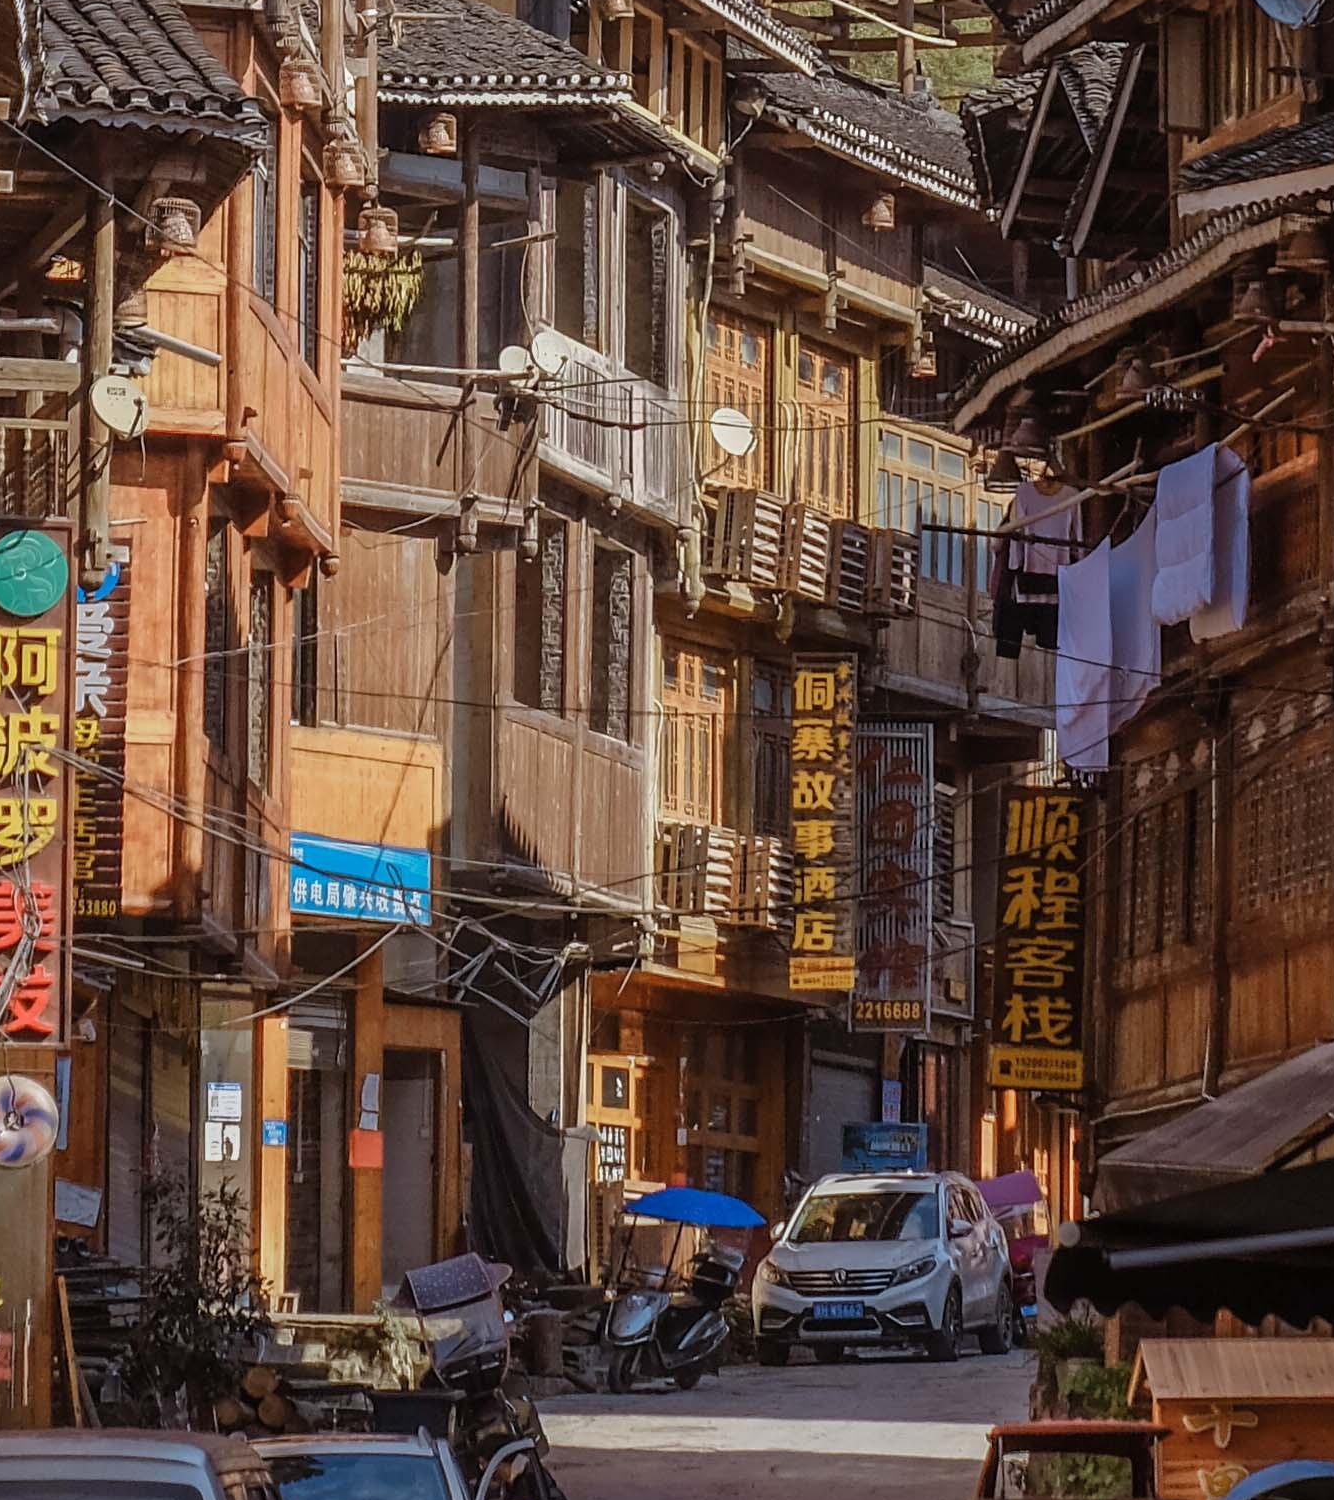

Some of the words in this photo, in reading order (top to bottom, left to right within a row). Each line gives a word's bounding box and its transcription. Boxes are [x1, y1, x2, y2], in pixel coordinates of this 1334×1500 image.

[792, 672, 836, 951] 侗寨故事酒店
[1002, 795, 1082, 1047] 顺程客栈
[855, 1002, 921, 1020] 2216688
